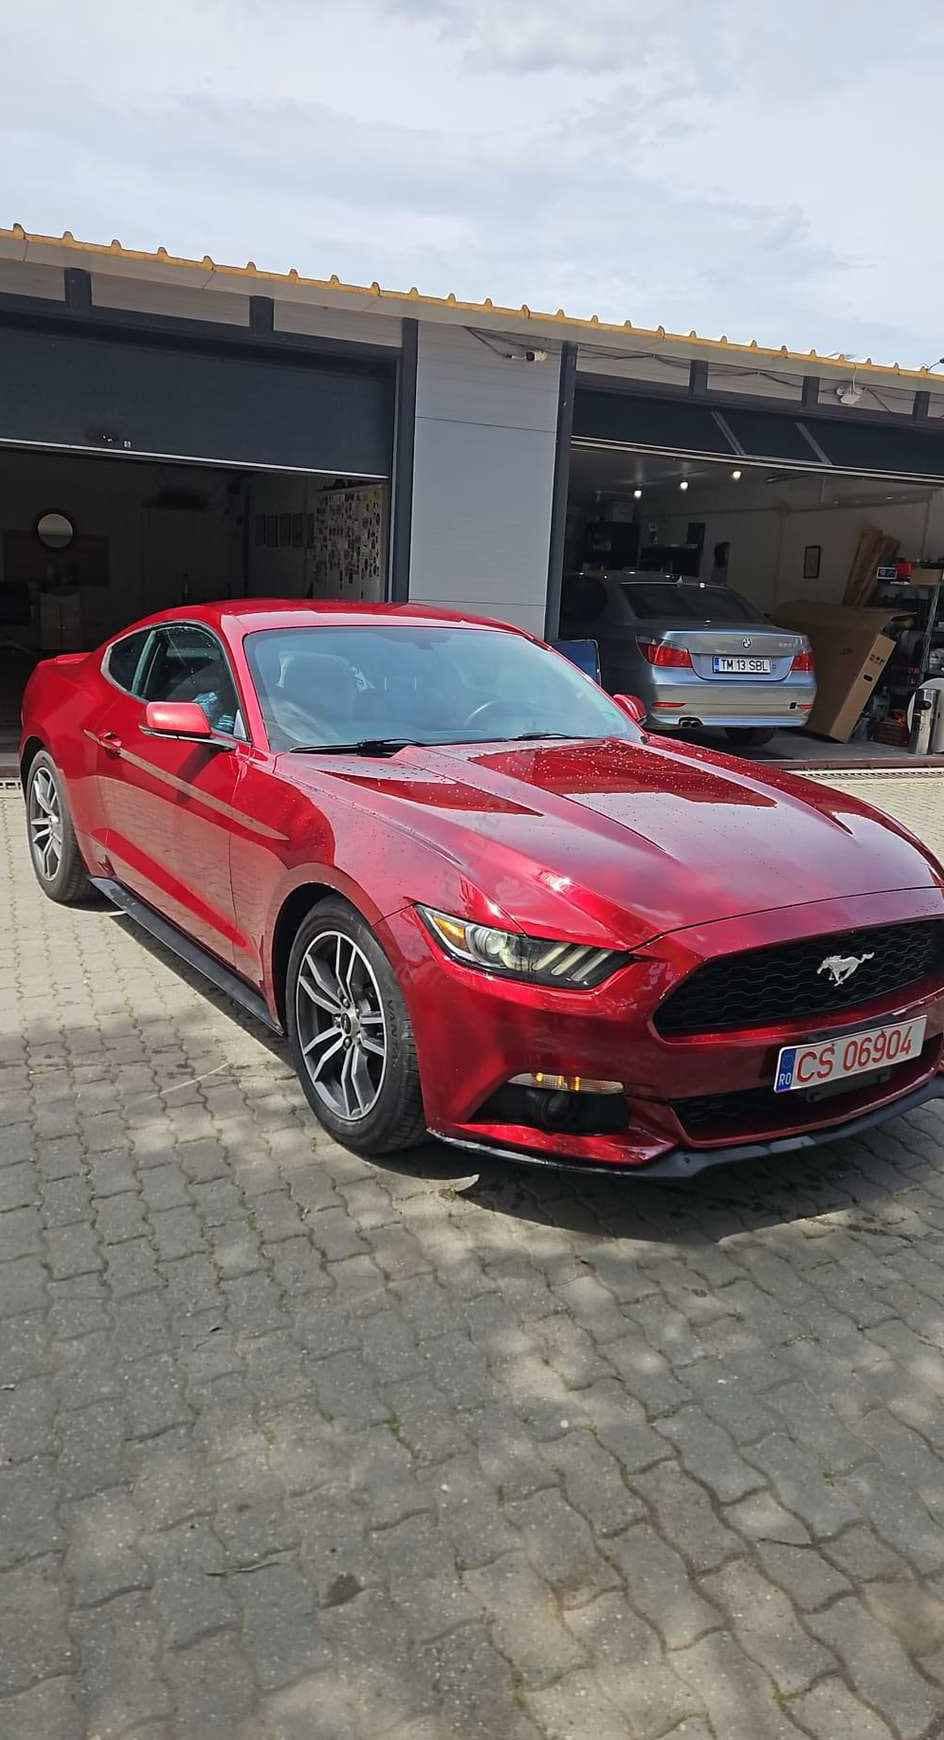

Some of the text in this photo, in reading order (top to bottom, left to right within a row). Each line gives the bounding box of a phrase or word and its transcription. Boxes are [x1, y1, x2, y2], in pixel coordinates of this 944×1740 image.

[721, 659, 768, 672] TM 13 SBL
[797, 1026, 912, 1083] CS 06904
[778, 1072, 792, 1086] RO
